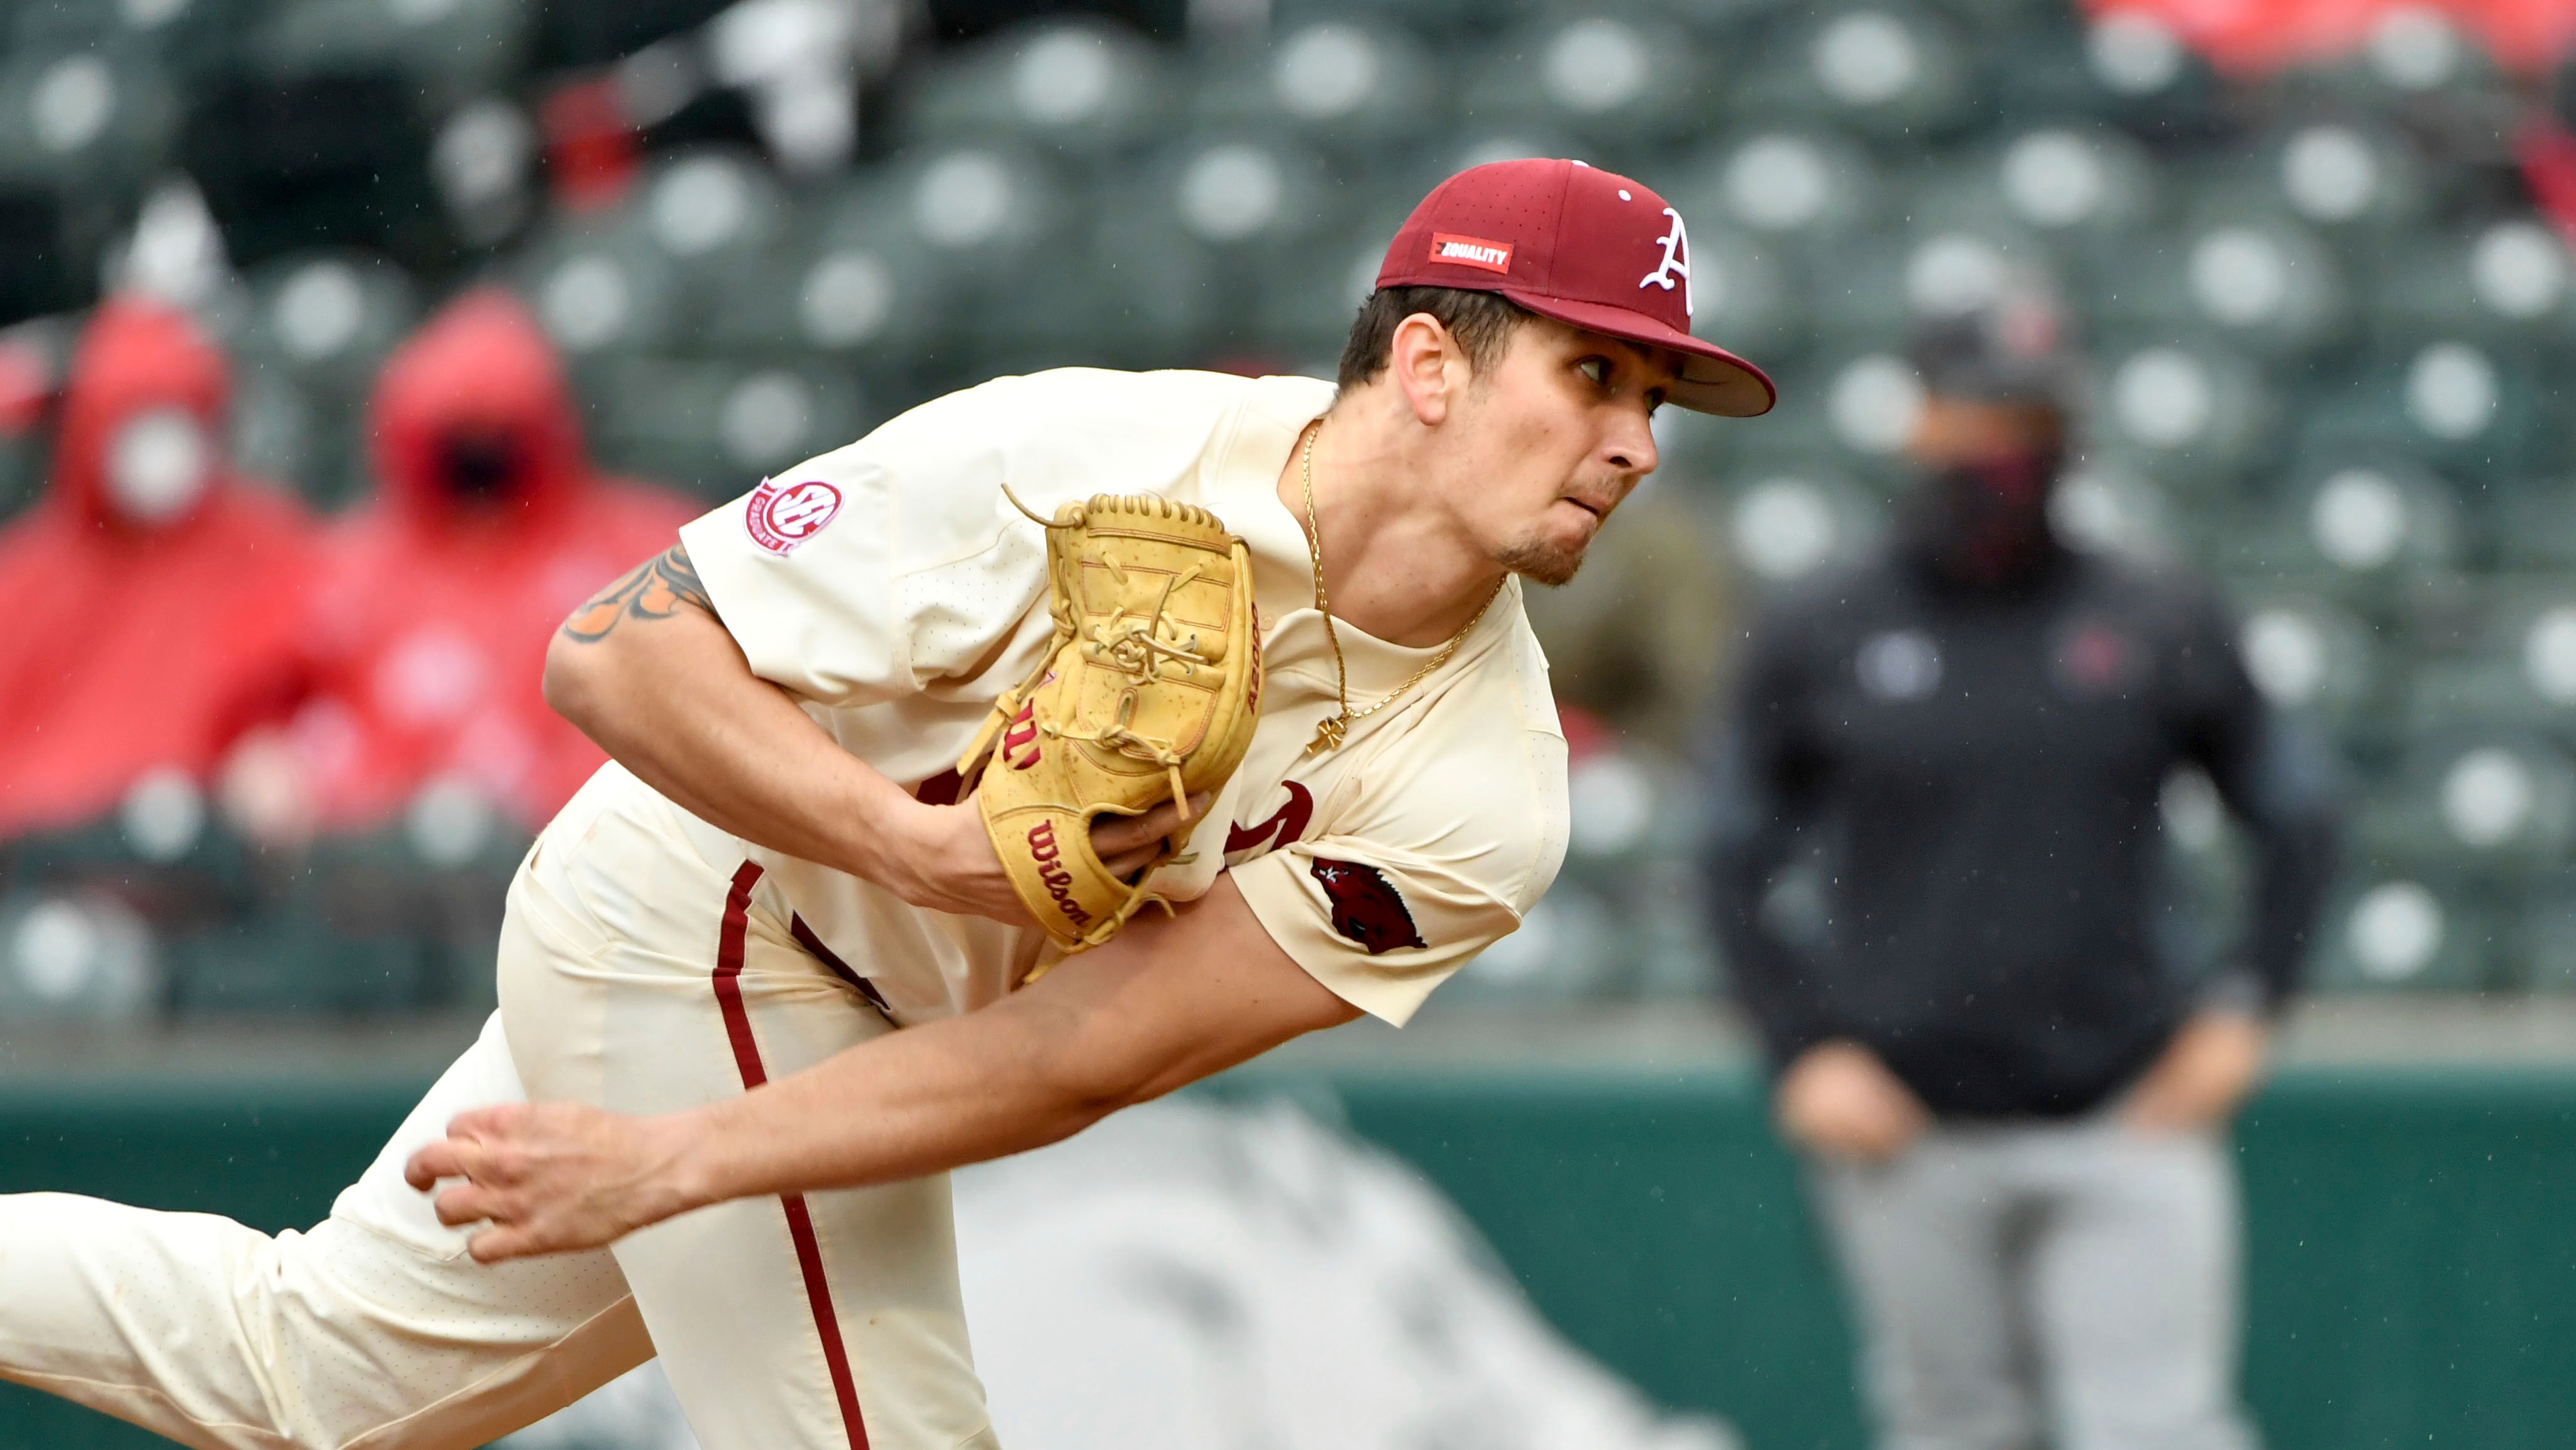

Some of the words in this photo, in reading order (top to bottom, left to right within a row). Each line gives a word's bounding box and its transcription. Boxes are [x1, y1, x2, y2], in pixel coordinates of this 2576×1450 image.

[1442, 242, 1507, 265] EQUALITY
[1640, 207, 1693, 317] A
[772, 485, 836, 535] SEC
[1028, 819, 1092, 927] Wilson
